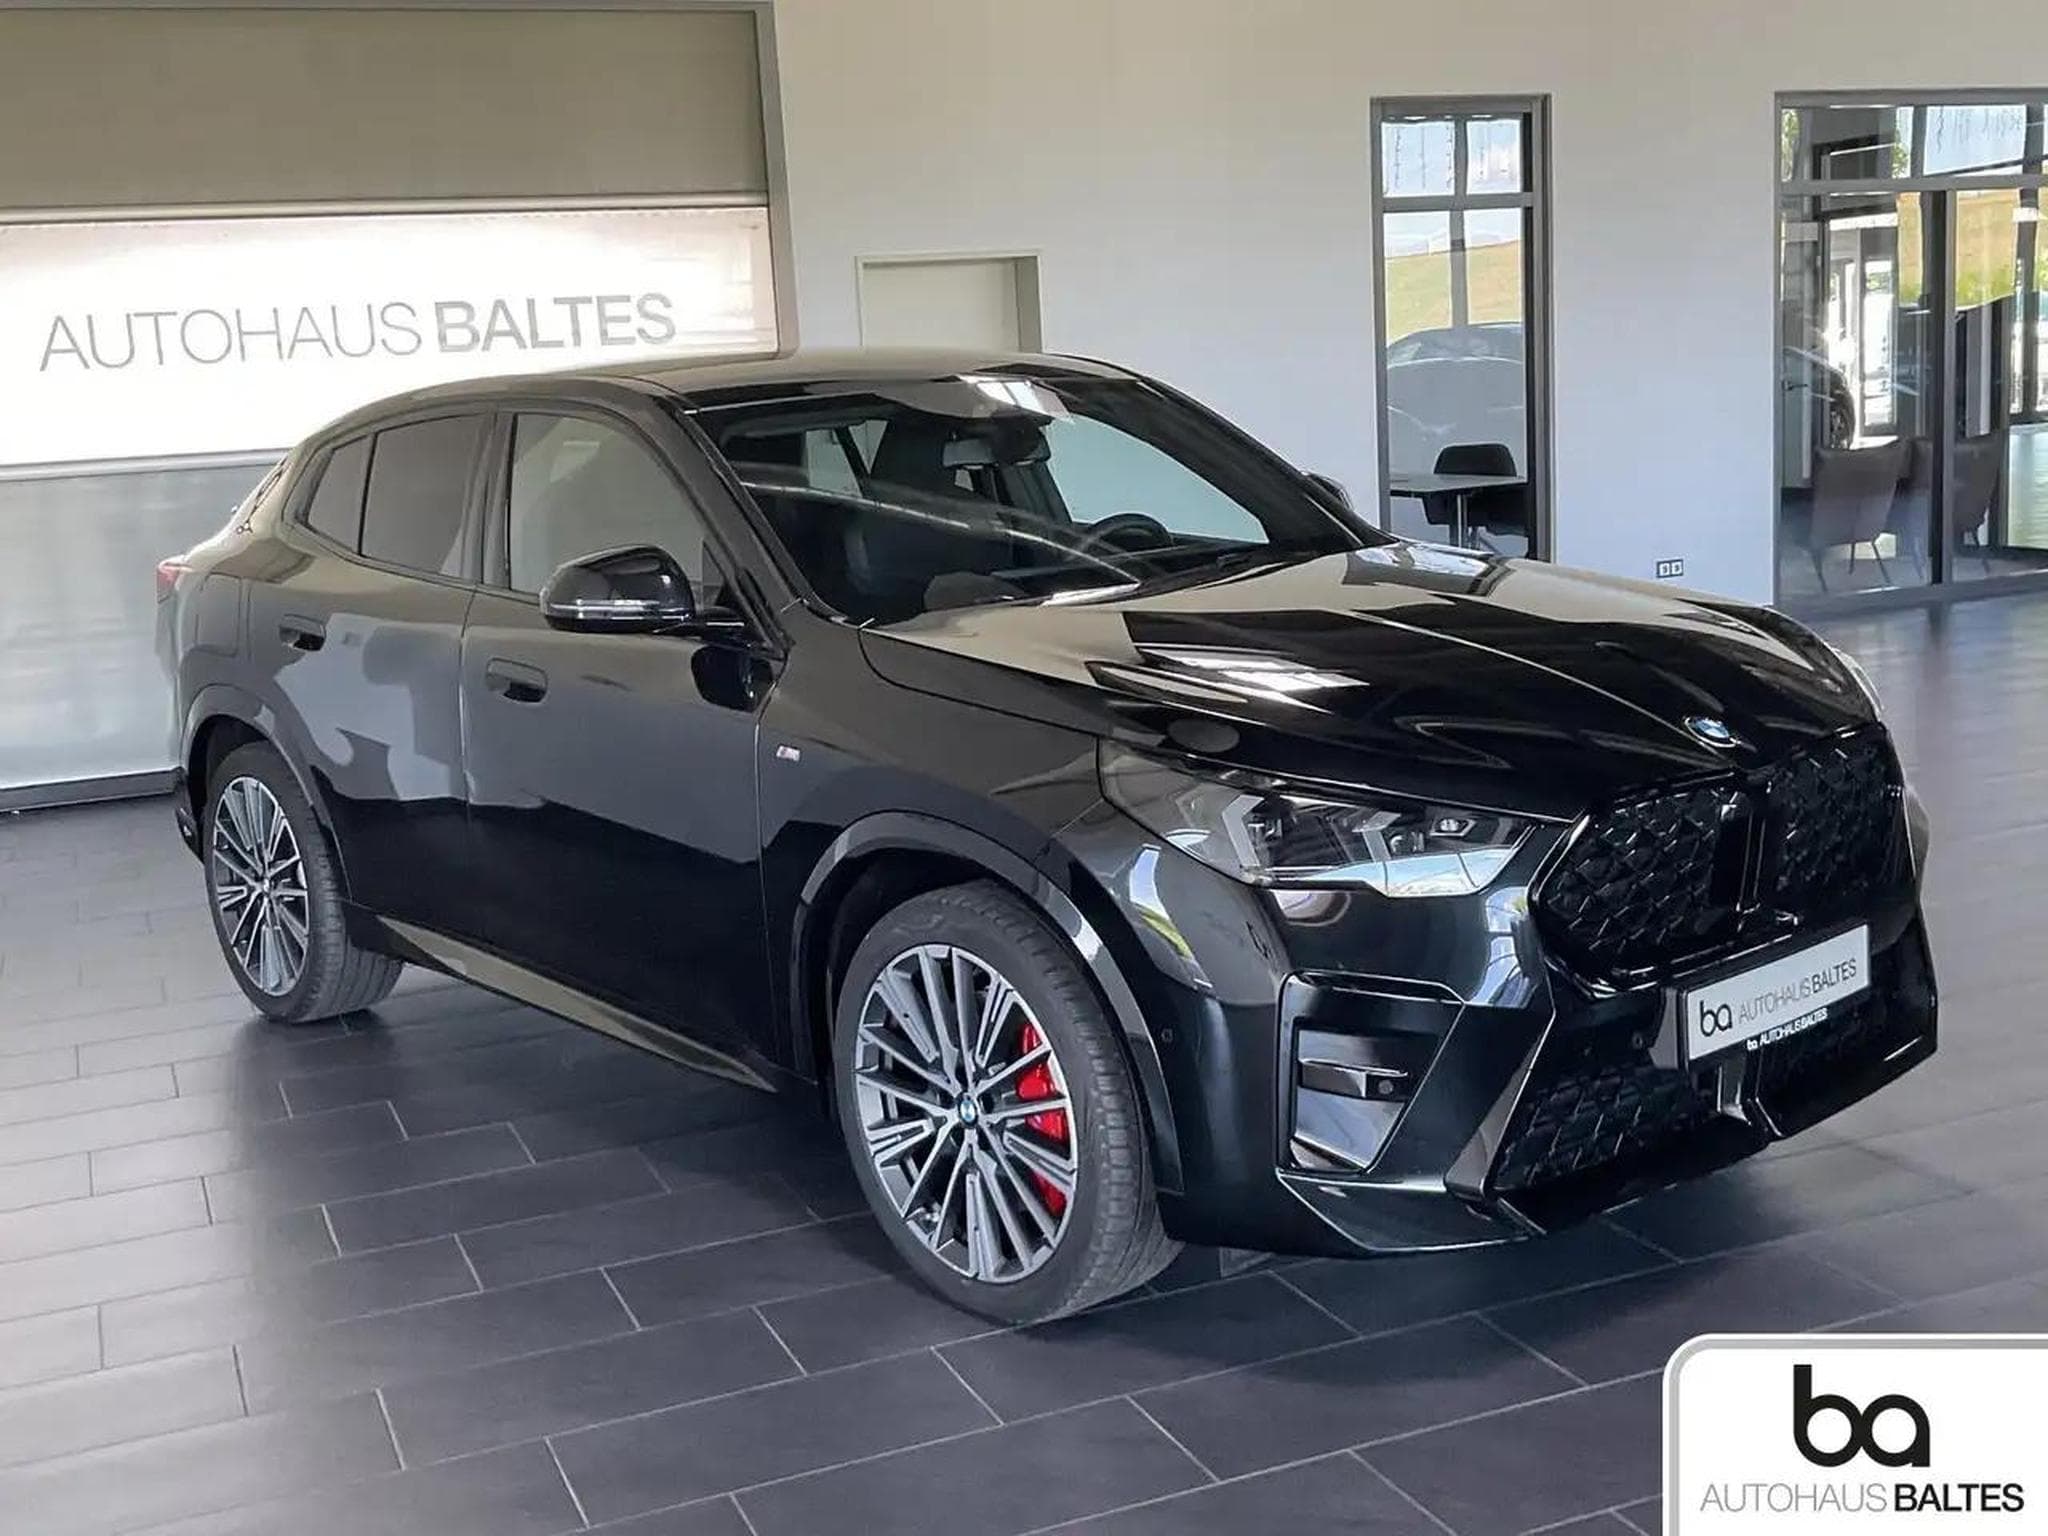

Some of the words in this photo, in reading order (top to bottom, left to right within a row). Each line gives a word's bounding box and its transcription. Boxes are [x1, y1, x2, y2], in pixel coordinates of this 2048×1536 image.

[40, 302, 422, 371] AUTOHAUS
[434, 293, 676, 353] BALTES
[1699, 1001, 1733, 1037] ba
[1738, 976, 1812, 1024] AUTOHAUS
[1811, 957, 1857, 994] BALTES
